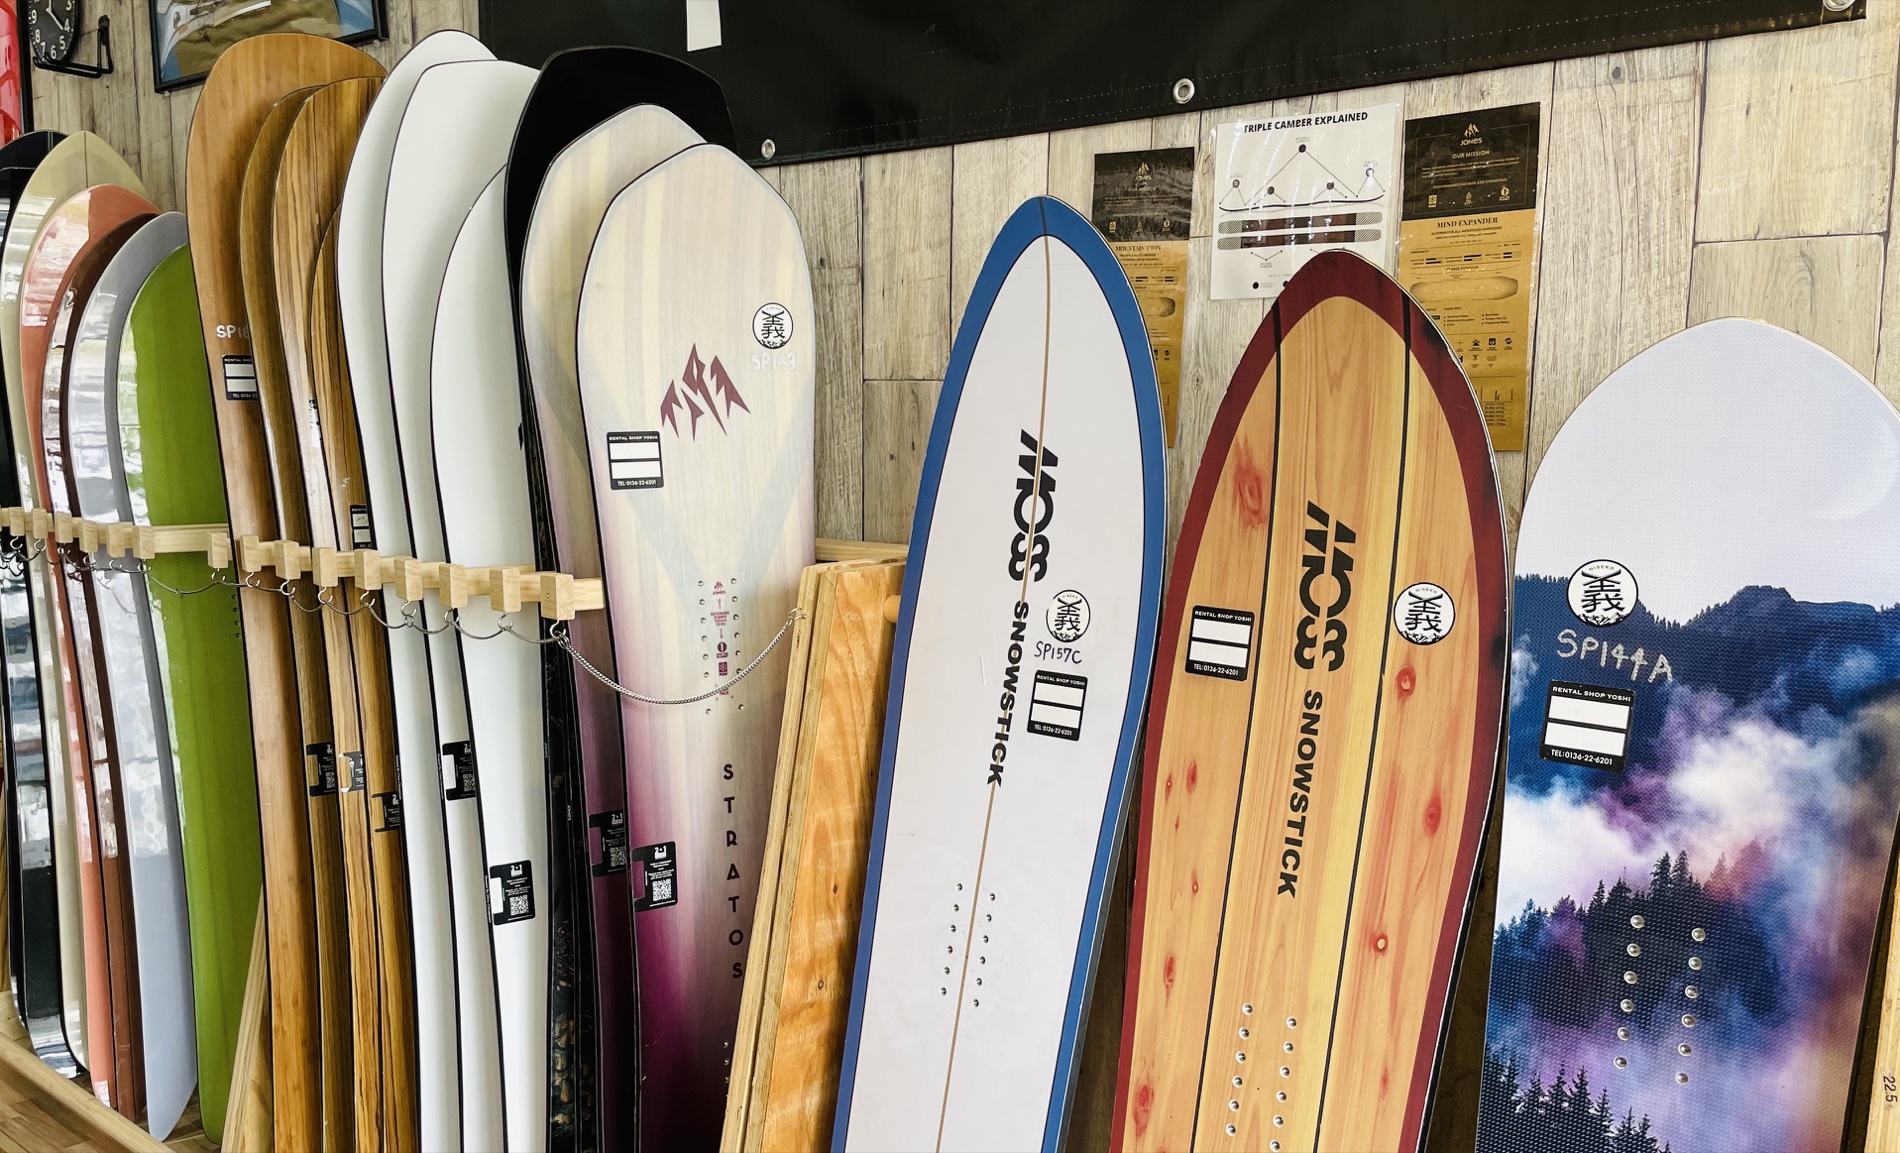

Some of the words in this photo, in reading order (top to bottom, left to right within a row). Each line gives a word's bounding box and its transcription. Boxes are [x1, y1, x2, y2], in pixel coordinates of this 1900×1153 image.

[32, 10, 37, 24] 9
[64, 18, 70, 32] 4
[35, 29, 40, 43] 8
[59, 36, 66, 50] 5
[40, 42, 46, 56] 7
[50, 45, 57, 60] 6
[1244, 122, 1272, 133] TRIPLE
[1274, 117, 1312, 130] CAMBER
[1314, 112, 1368, 126] EXPLAINED
[1458, 217, 1498, 227] EXPANDER
[1034, 641, 1082, 664] SP157C
[1556, 628, 1673, 685] SP144A
[1194, 663, 1239, 676] TEL:0136-22-6201
[987, 600, 1029, 786] SNOWSTICK
[1552, 686, 1582, 696] RENTAL
[1584, 690, 1606, 698] SHOP
[1608, 694, 1631, 702] YOSHI
[1550, 749, 1612, 765] TEL:0136-22-6201
[1278, 690, 1323, 898] SNOWSTICK
[724, 764, 744, 978] STRATOS
[1883, 1076, 1898, 1102] 22.5
